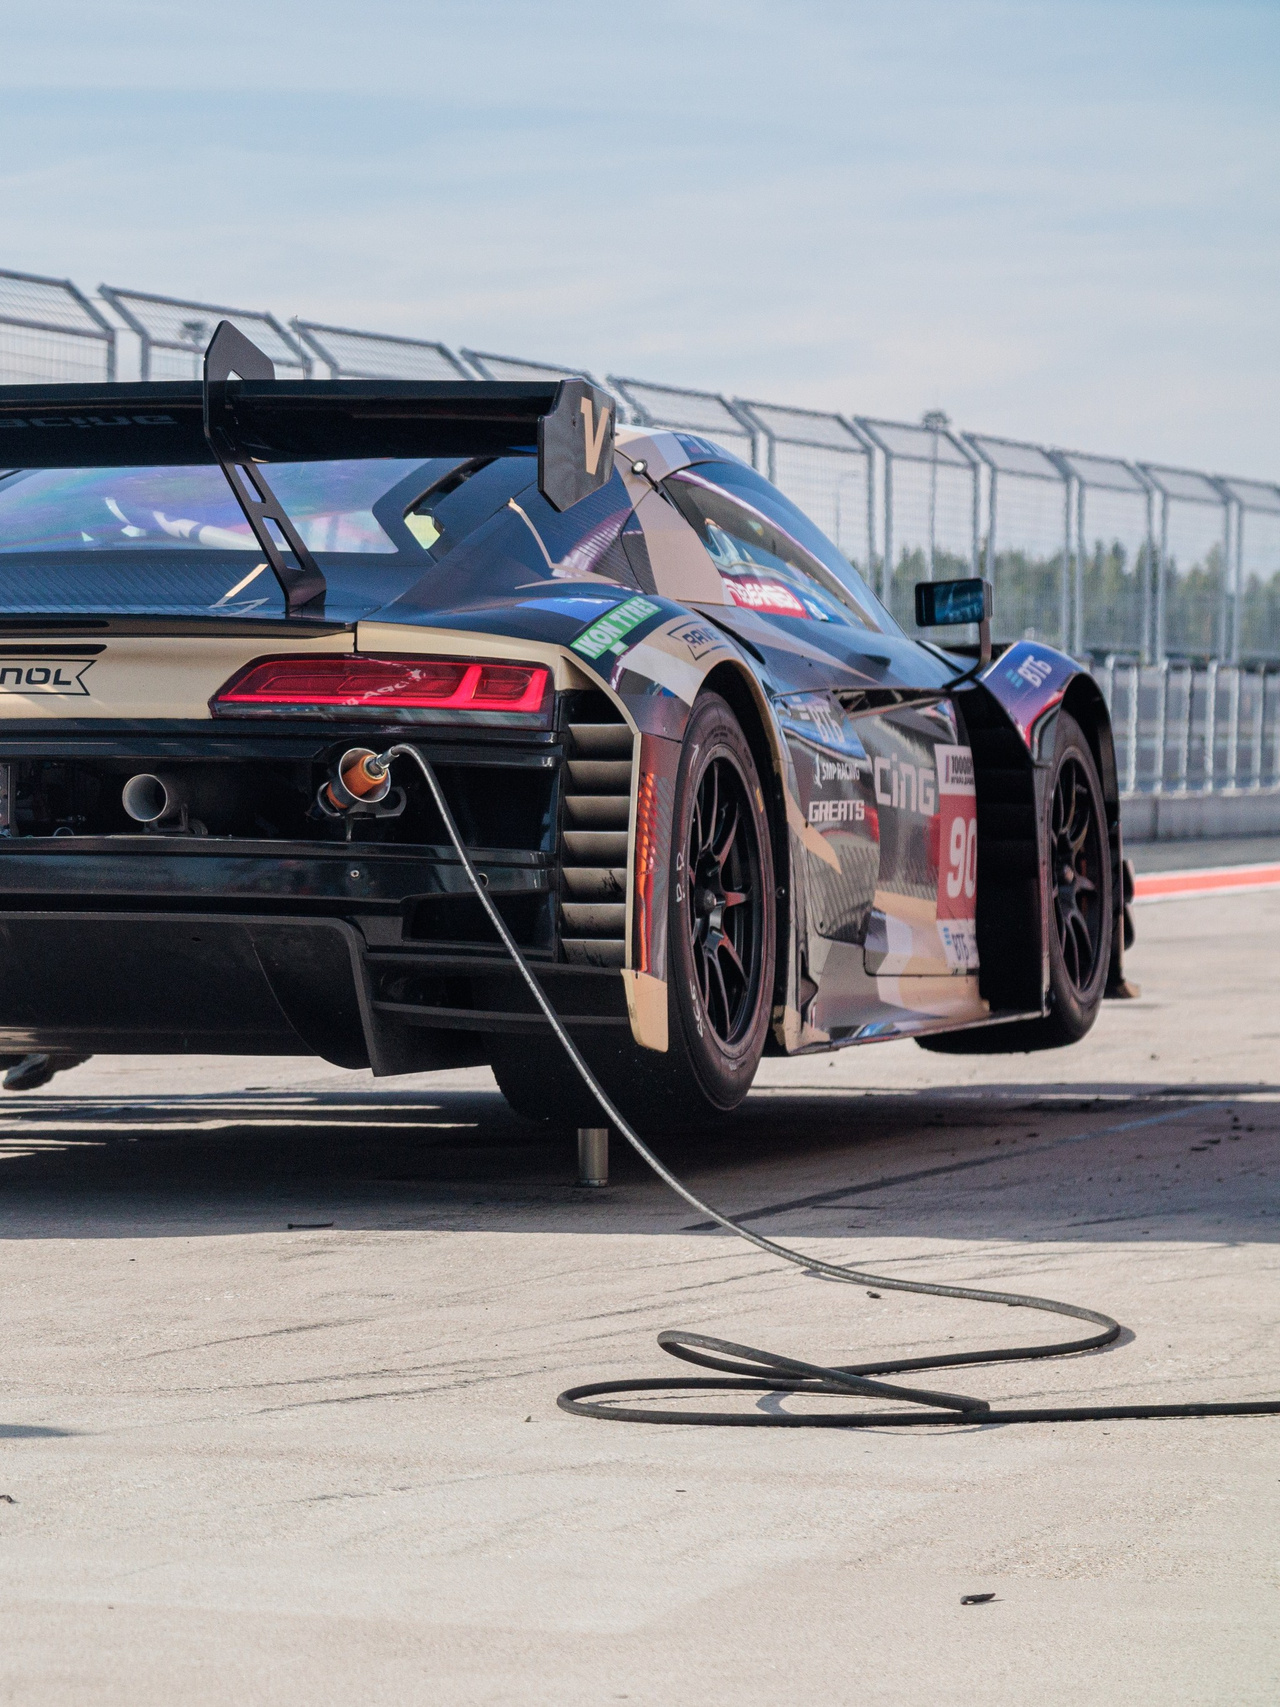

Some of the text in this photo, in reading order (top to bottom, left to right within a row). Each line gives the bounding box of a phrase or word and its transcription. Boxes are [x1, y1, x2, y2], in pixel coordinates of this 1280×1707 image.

[573, 598, 659, 657] IKON TYRES
[822, 762, 860, 780] SMP RACING
[808, 801, 865, 822] GREATS
[947, 816, 977, 899] 90
